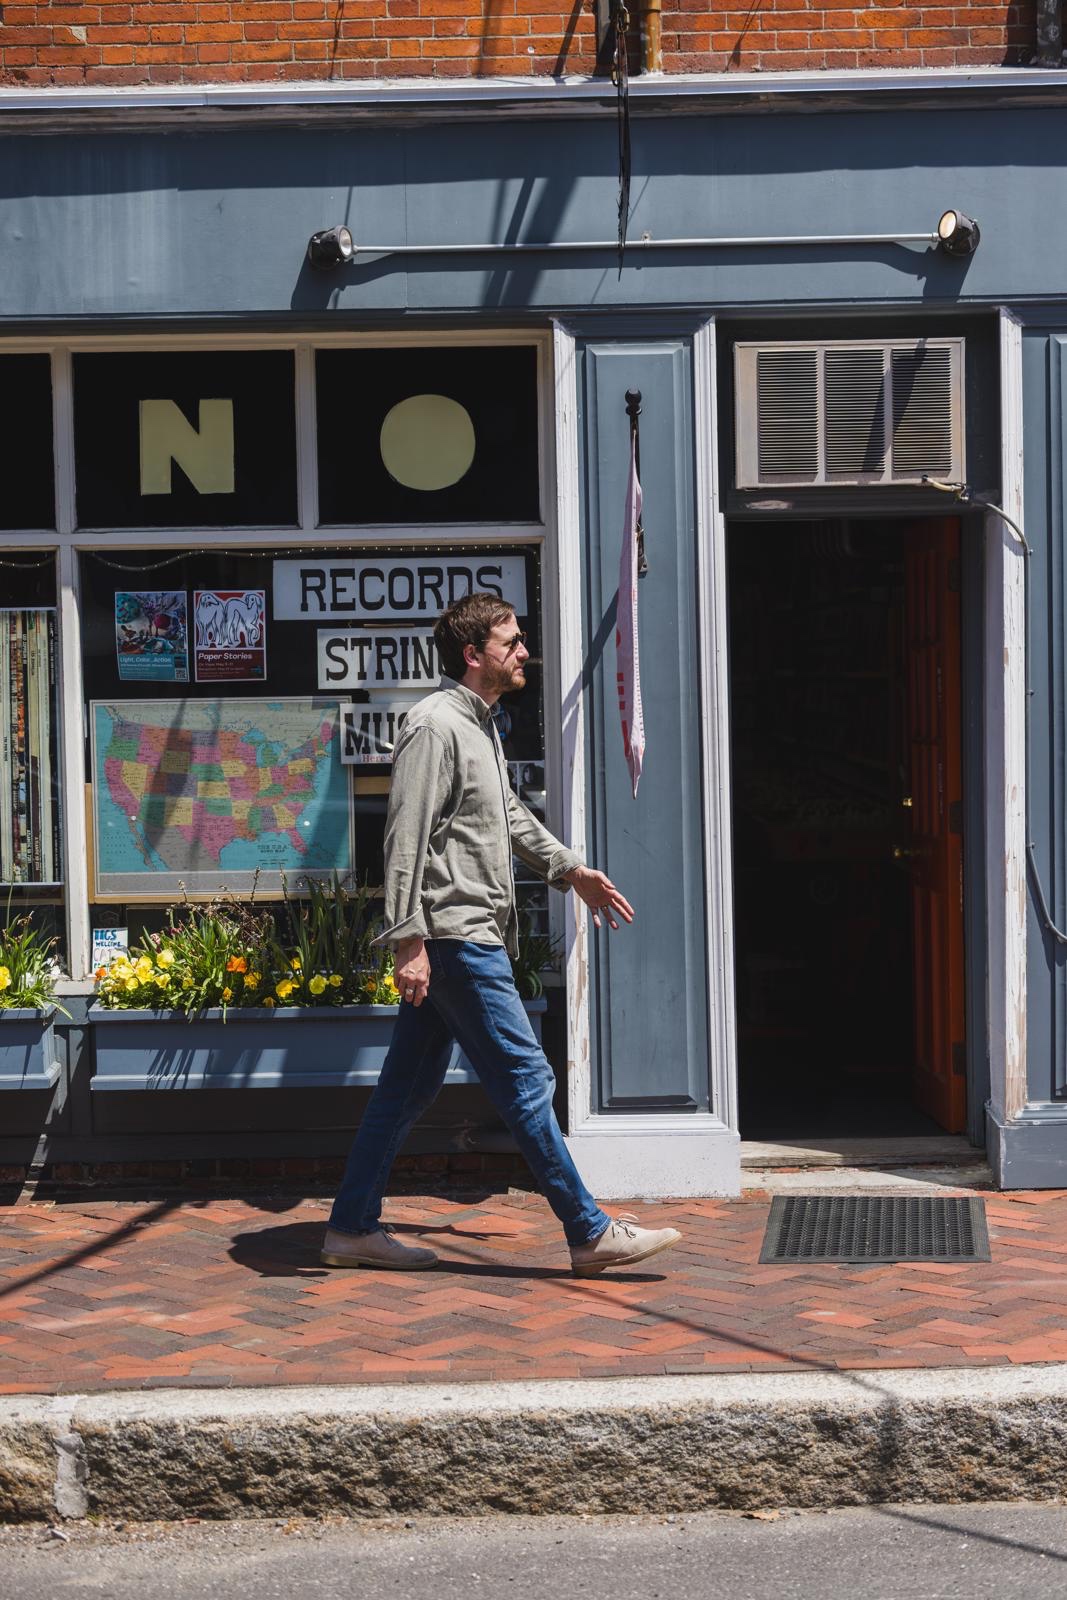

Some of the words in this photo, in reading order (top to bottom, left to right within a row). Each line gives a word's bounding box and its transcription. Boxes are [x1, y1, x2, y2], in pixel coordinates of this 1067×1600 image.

[300, 565, 503, 612] RECORDS
[198, 652, 222, 662] Paper
[223, 652, 253, 660] Stories
[325, 636, 445, 682] STRIN
[344, 711, 408, 756] MU
[362, 753, 386, 763] Here
